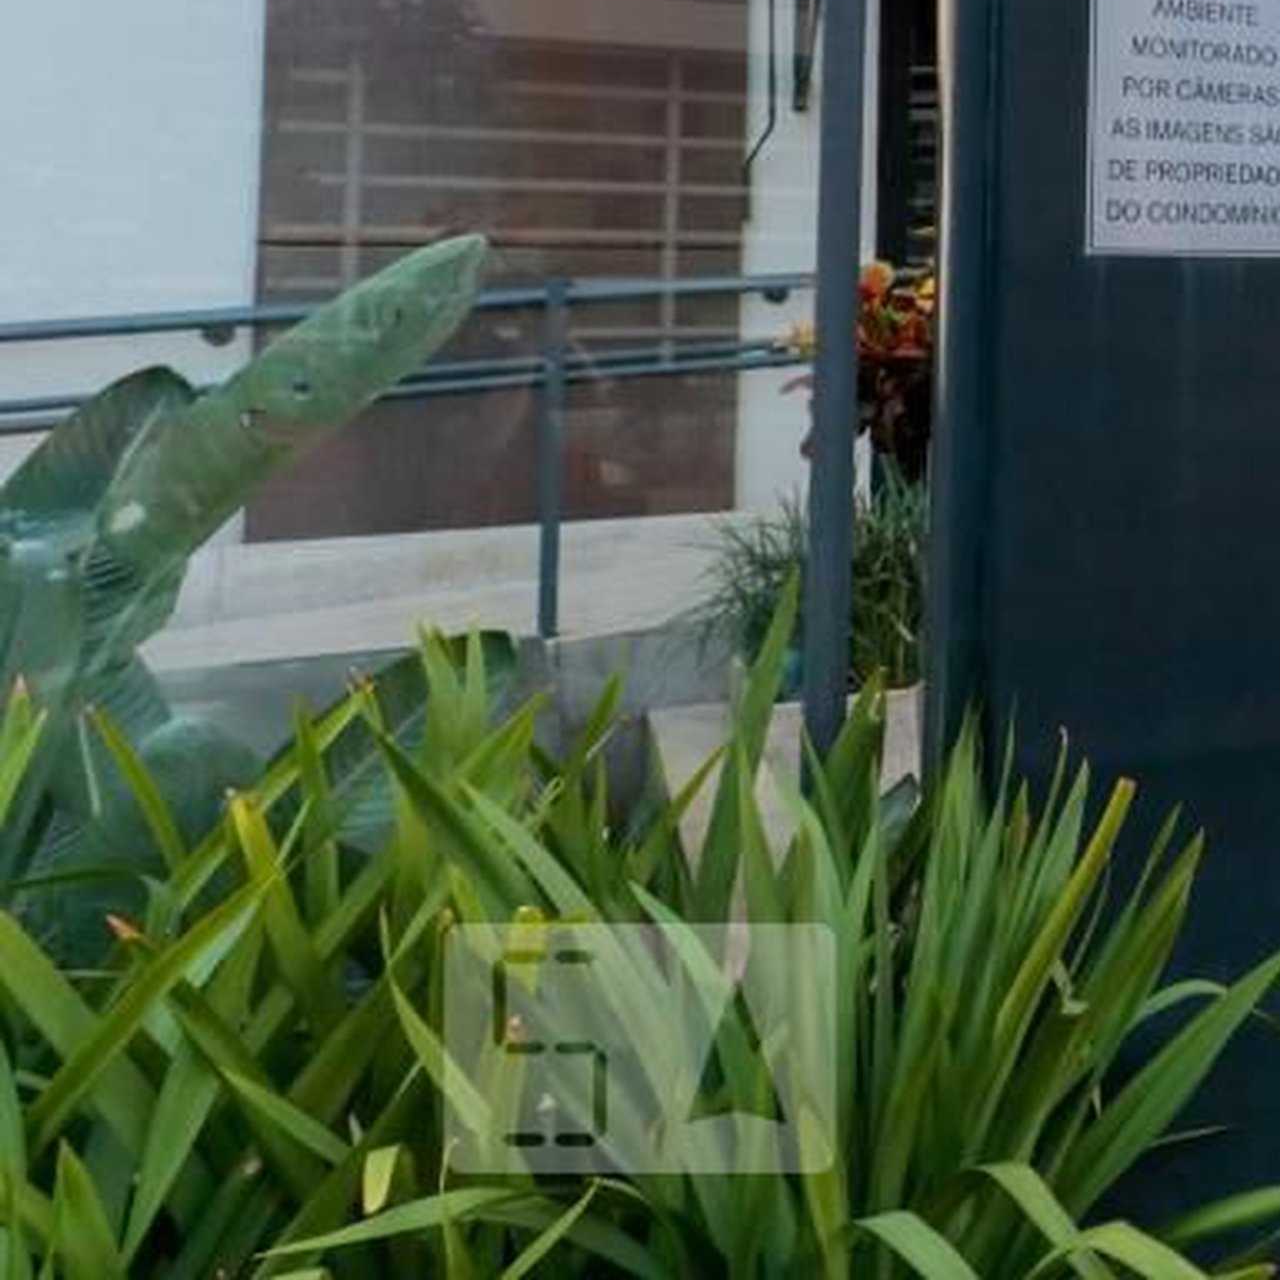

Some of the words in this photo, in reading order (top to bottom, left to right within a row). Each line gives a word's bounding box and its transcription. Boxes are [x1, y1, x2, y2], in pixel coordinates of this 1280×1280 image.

[1131, 35, 1278, 68] MONITORADO
[1121, 76, 1171, 100] POR
[1110, 117, 1141, 139] AS
[1145, 118, 1243, 144] IMAGENS
[1107, 159, 1138, 182] DE
[1105, 199, 1141, 224] DO
